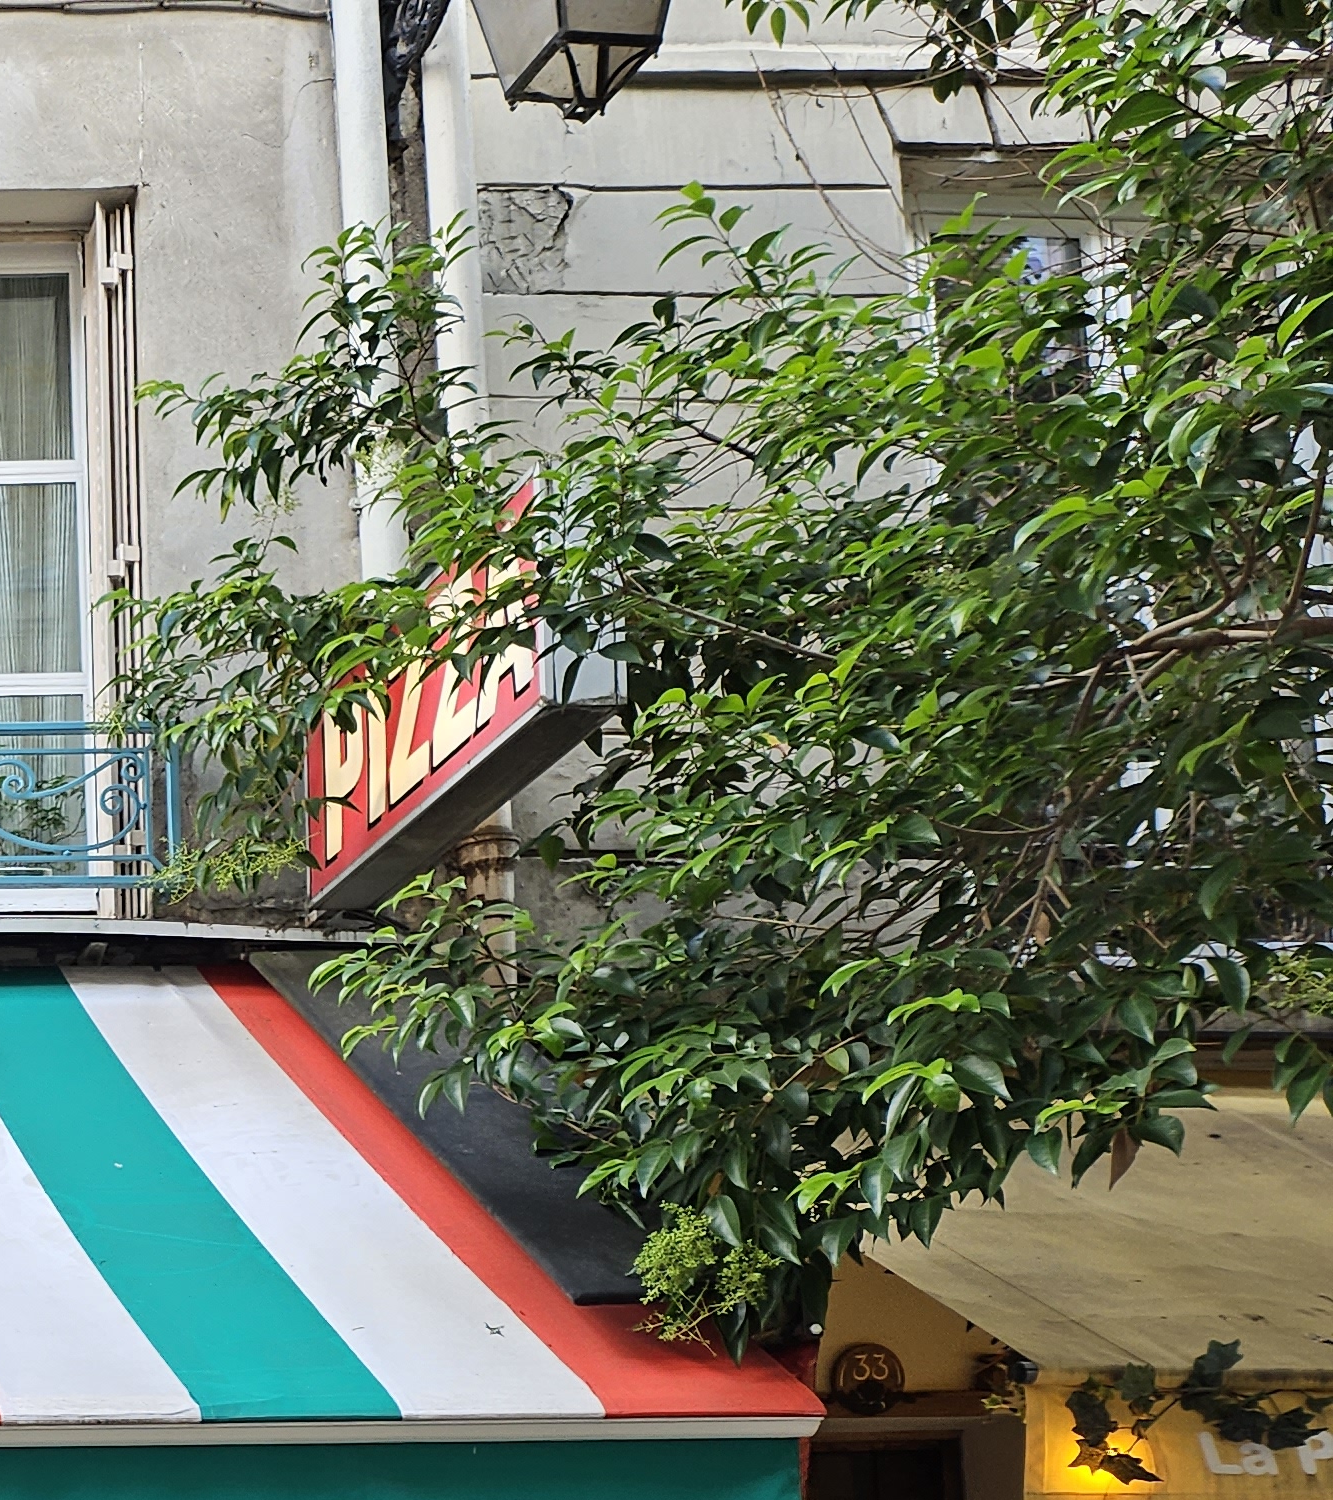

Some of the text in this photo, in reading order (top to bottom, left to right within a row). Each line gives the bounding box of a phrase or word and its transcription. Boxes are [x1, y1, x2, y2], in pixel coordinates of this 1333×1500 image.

[323, 555, 537, 861] PIZZA
[851, 1352, 890, 1383] 33
[1197, 1431, 1279, 1475] La
